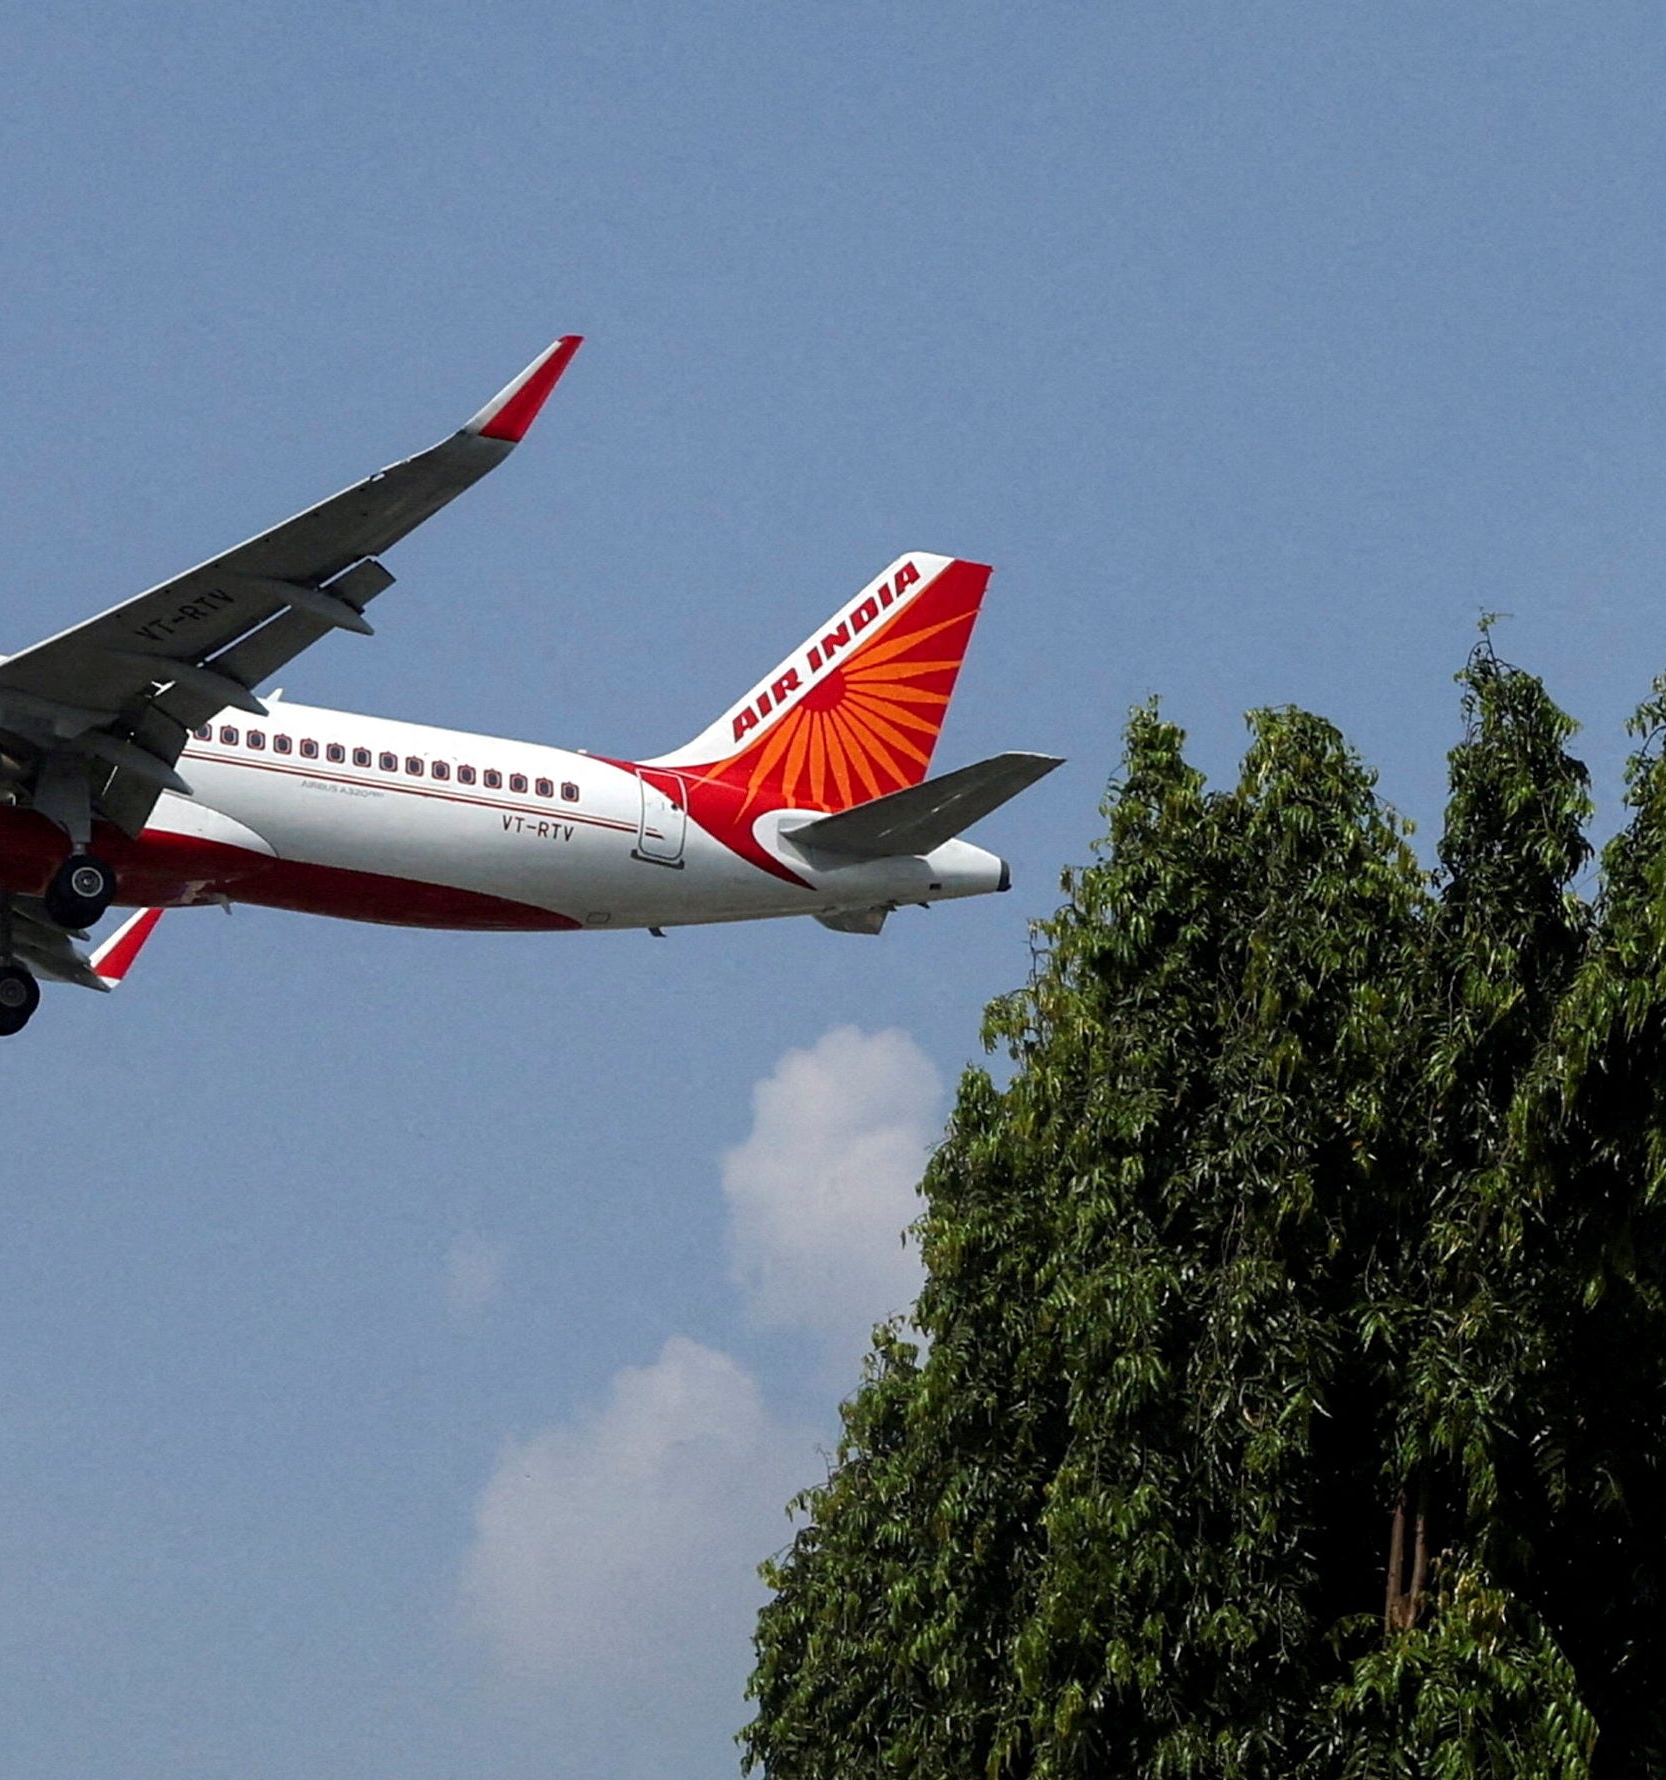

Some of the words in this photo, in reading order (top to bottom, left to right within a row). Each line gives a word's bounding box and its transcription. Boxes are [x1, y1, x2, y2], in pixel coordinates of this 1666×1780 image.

[133, 588, 235, 641] VT-RTV
[732, 667, 803, 743] AIR
[806, 561, 921, 674] INDIA
[502, 814, 574, 842] VT-RTV
